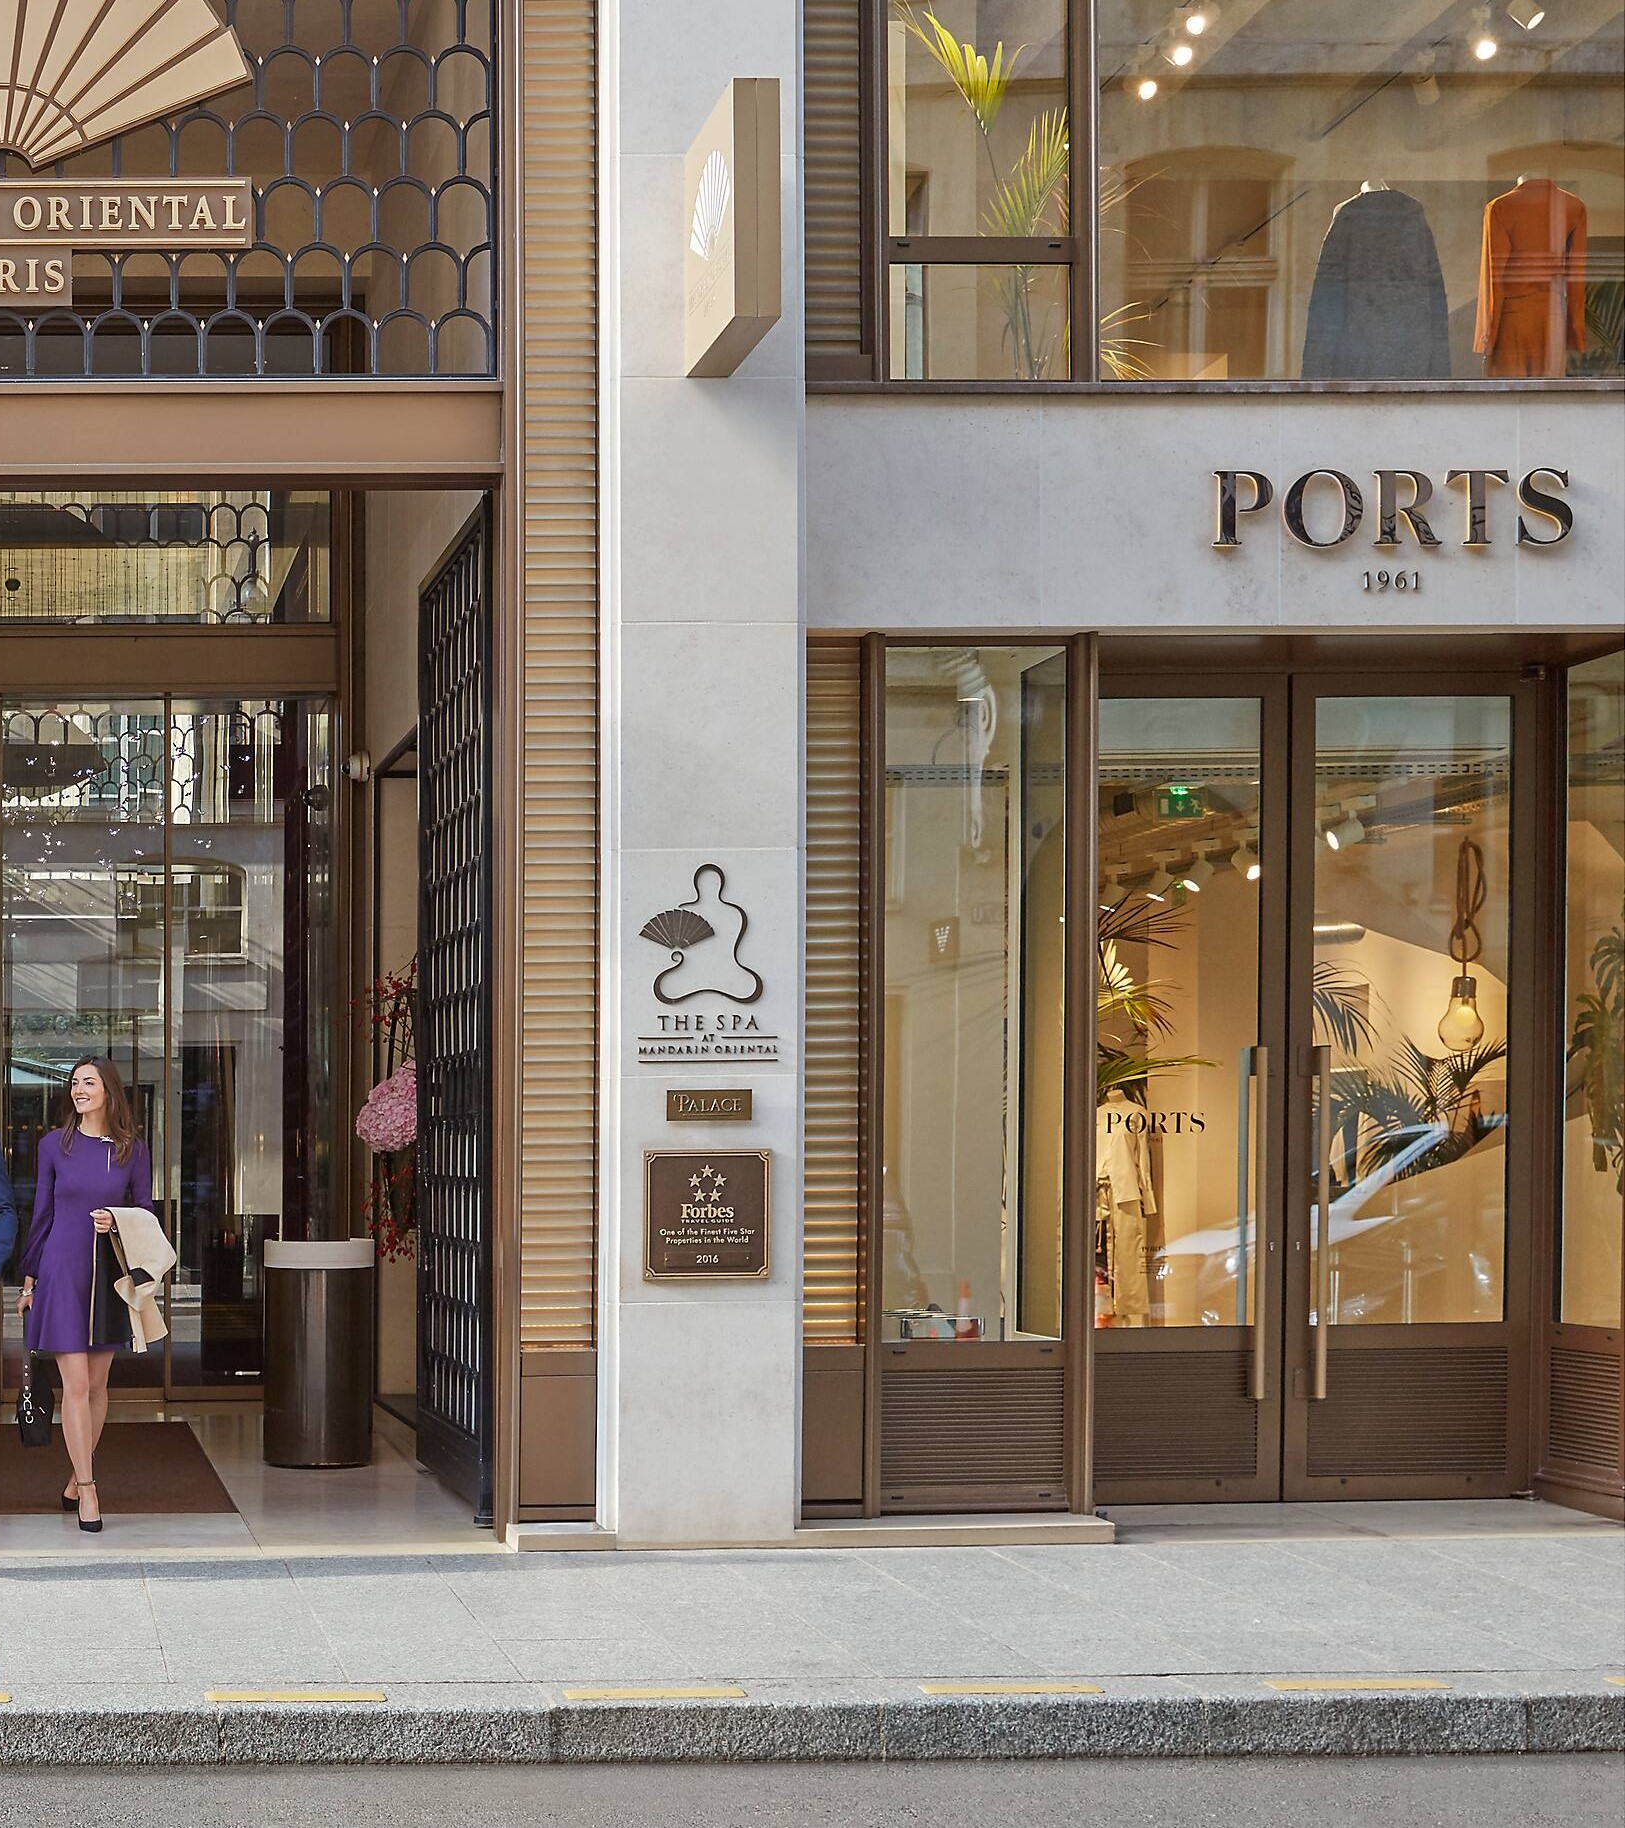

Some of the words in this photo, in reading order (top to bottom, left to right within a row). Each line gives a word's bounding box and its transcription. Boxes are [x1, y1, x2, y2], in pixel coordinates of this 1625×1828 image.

[12, 195, 248, 232] ORIENTAL
[1210, 467, 1575, 549] PORTS
[1361, 569, 1423, 592] 1961
[657, 1014, 704, 1031] THE
[716, 1013, 760, 1030] SPA
[701, 1033, 716, 1042] AT
[638, 1045, 709, 1055] MANDARIN
[714, 1044, 778, 1054] ORIENTAL
[1105, 1111, 1207, 1134] PORTS
[680, 1203, 735, 1218] Forbes
[659, 1228, 676, 1236] One
[677, 1227, 686, 1236] of
[687, 1227, 699, 1236] the
[700, 1228, 722, 1236] Finest
[723, 1227, 738, 1235] Five
[739, 1227, 755, 1235] Star
[665, 1237, 702, 1246] Properties
[704, 1236, 712, 1244] in
[713, 1235, 725, 1244] the
[726, 1235, 750, 1244] World
[696, 1254, 720, 1264] 2016
